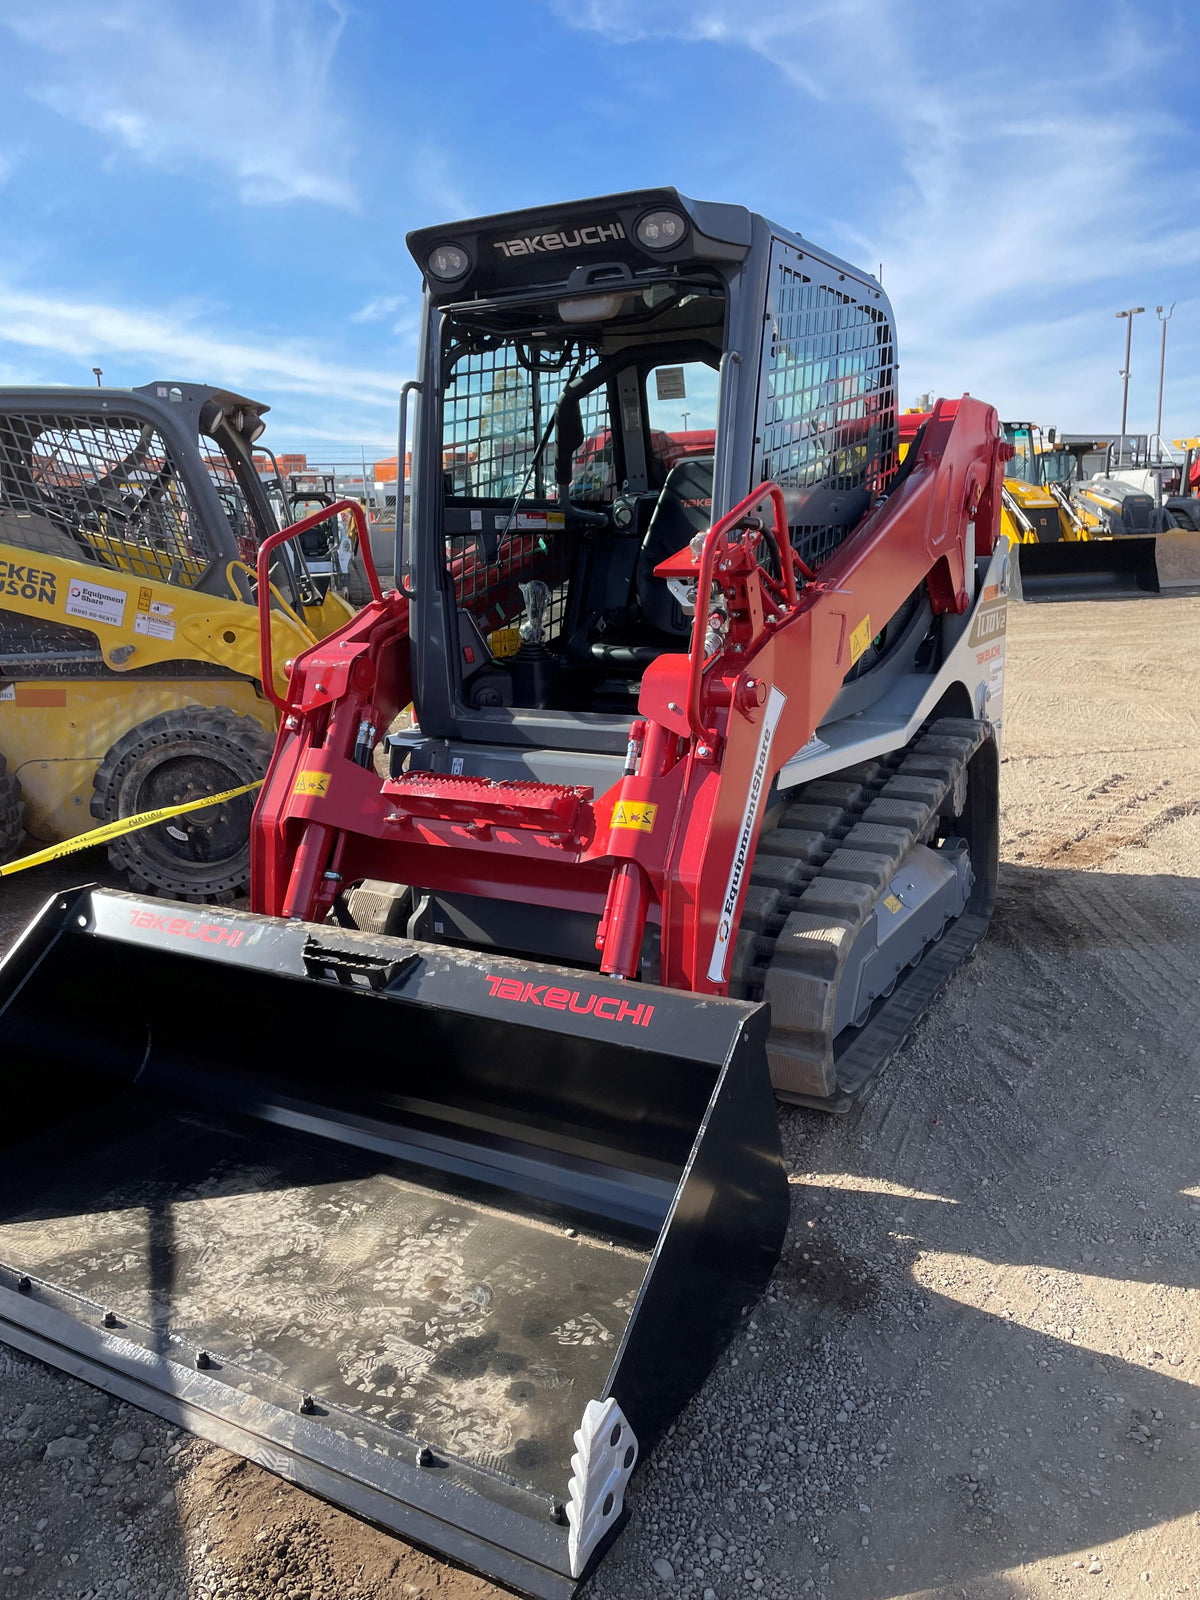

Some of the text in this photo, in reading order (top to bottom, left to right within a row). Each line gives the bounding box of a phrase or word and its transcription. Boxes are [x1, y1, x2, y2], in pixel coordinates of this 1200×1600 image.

[493, 222, 625, 257] TAKEUCHI
[81, 594, 104, 606] Share
[82, 588, 124, 604] Equipment
[724, 727, 771, 917] EquipmentShare
[129, 909, 246, 949] TAKEUCHI
[485, 974, 655, 1027] TAKEUCHI
